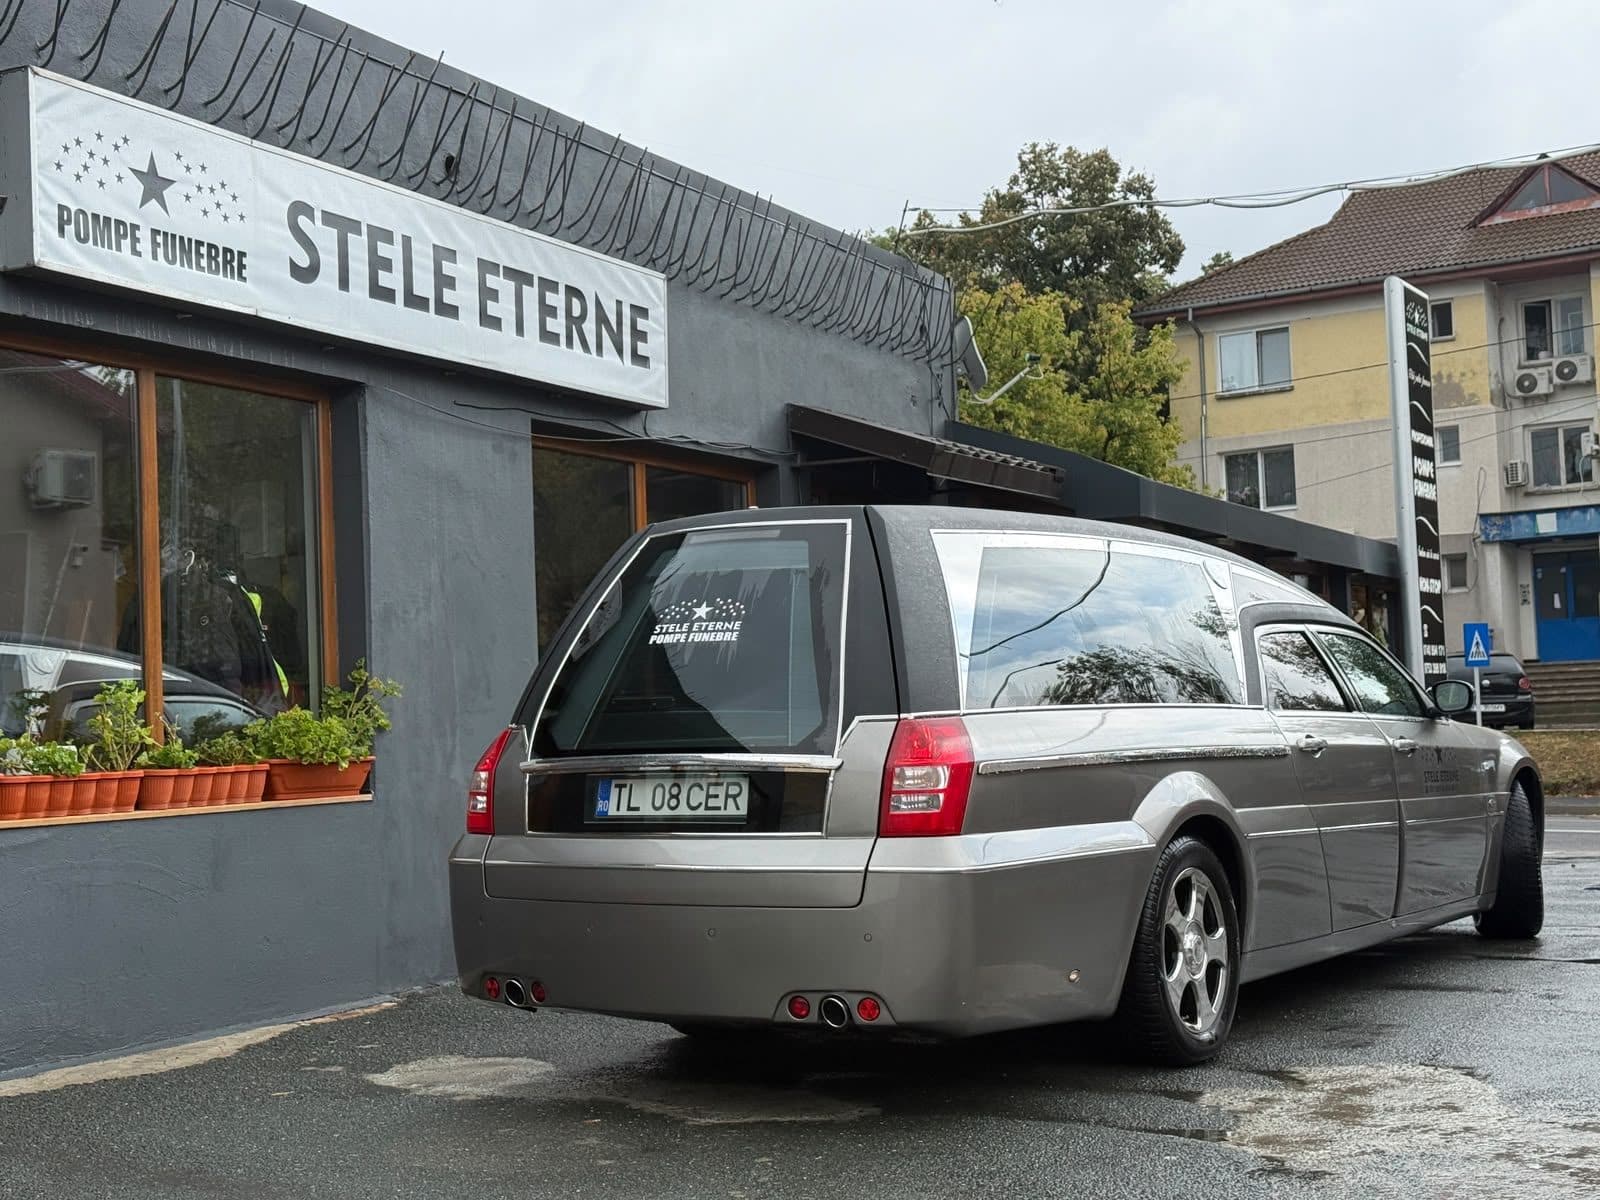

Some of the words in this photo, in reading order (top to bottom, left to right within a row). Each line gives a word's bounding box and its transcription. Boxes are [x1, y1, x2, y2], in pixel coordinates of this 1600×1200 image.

[57, 202, 141, 257] POMPE
[150, 230, 248, 283] FUNEBRE
[287, 199, 459, 321] STELE
[476, 256, 651, 370] ETERNE
[648, 633, 688, 645] POMPE
[688, 631, 740, 643] FUNEBRE
[653, 622, 690, 634] STELE
[692, 621, 743, 632] ETERNE
[597, 799, 609, 812] RO
[614, 783, 641, 812] TL
[686, 781, 744, 812] CER
